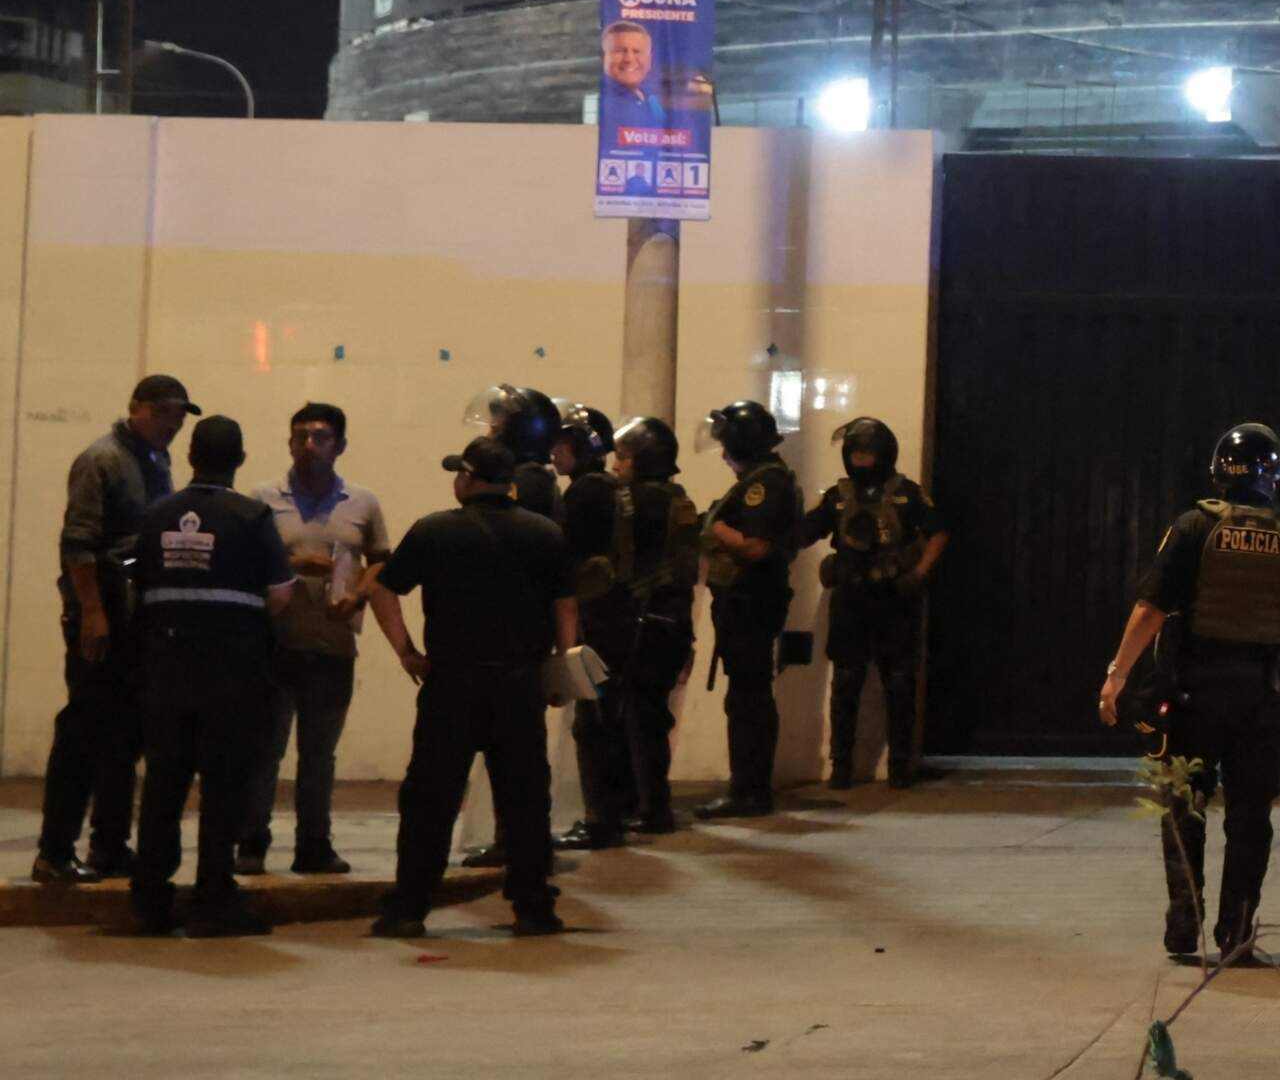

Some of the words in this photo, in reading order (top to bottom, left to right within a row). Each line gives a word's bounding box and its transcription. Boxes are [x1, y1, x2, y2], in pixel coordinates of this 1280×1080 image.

[621, 7, 695, 22] PRESIDENTE
[623, 130, 657, 144] Vota
[1220, 529, 1280, 554] POLICIA
